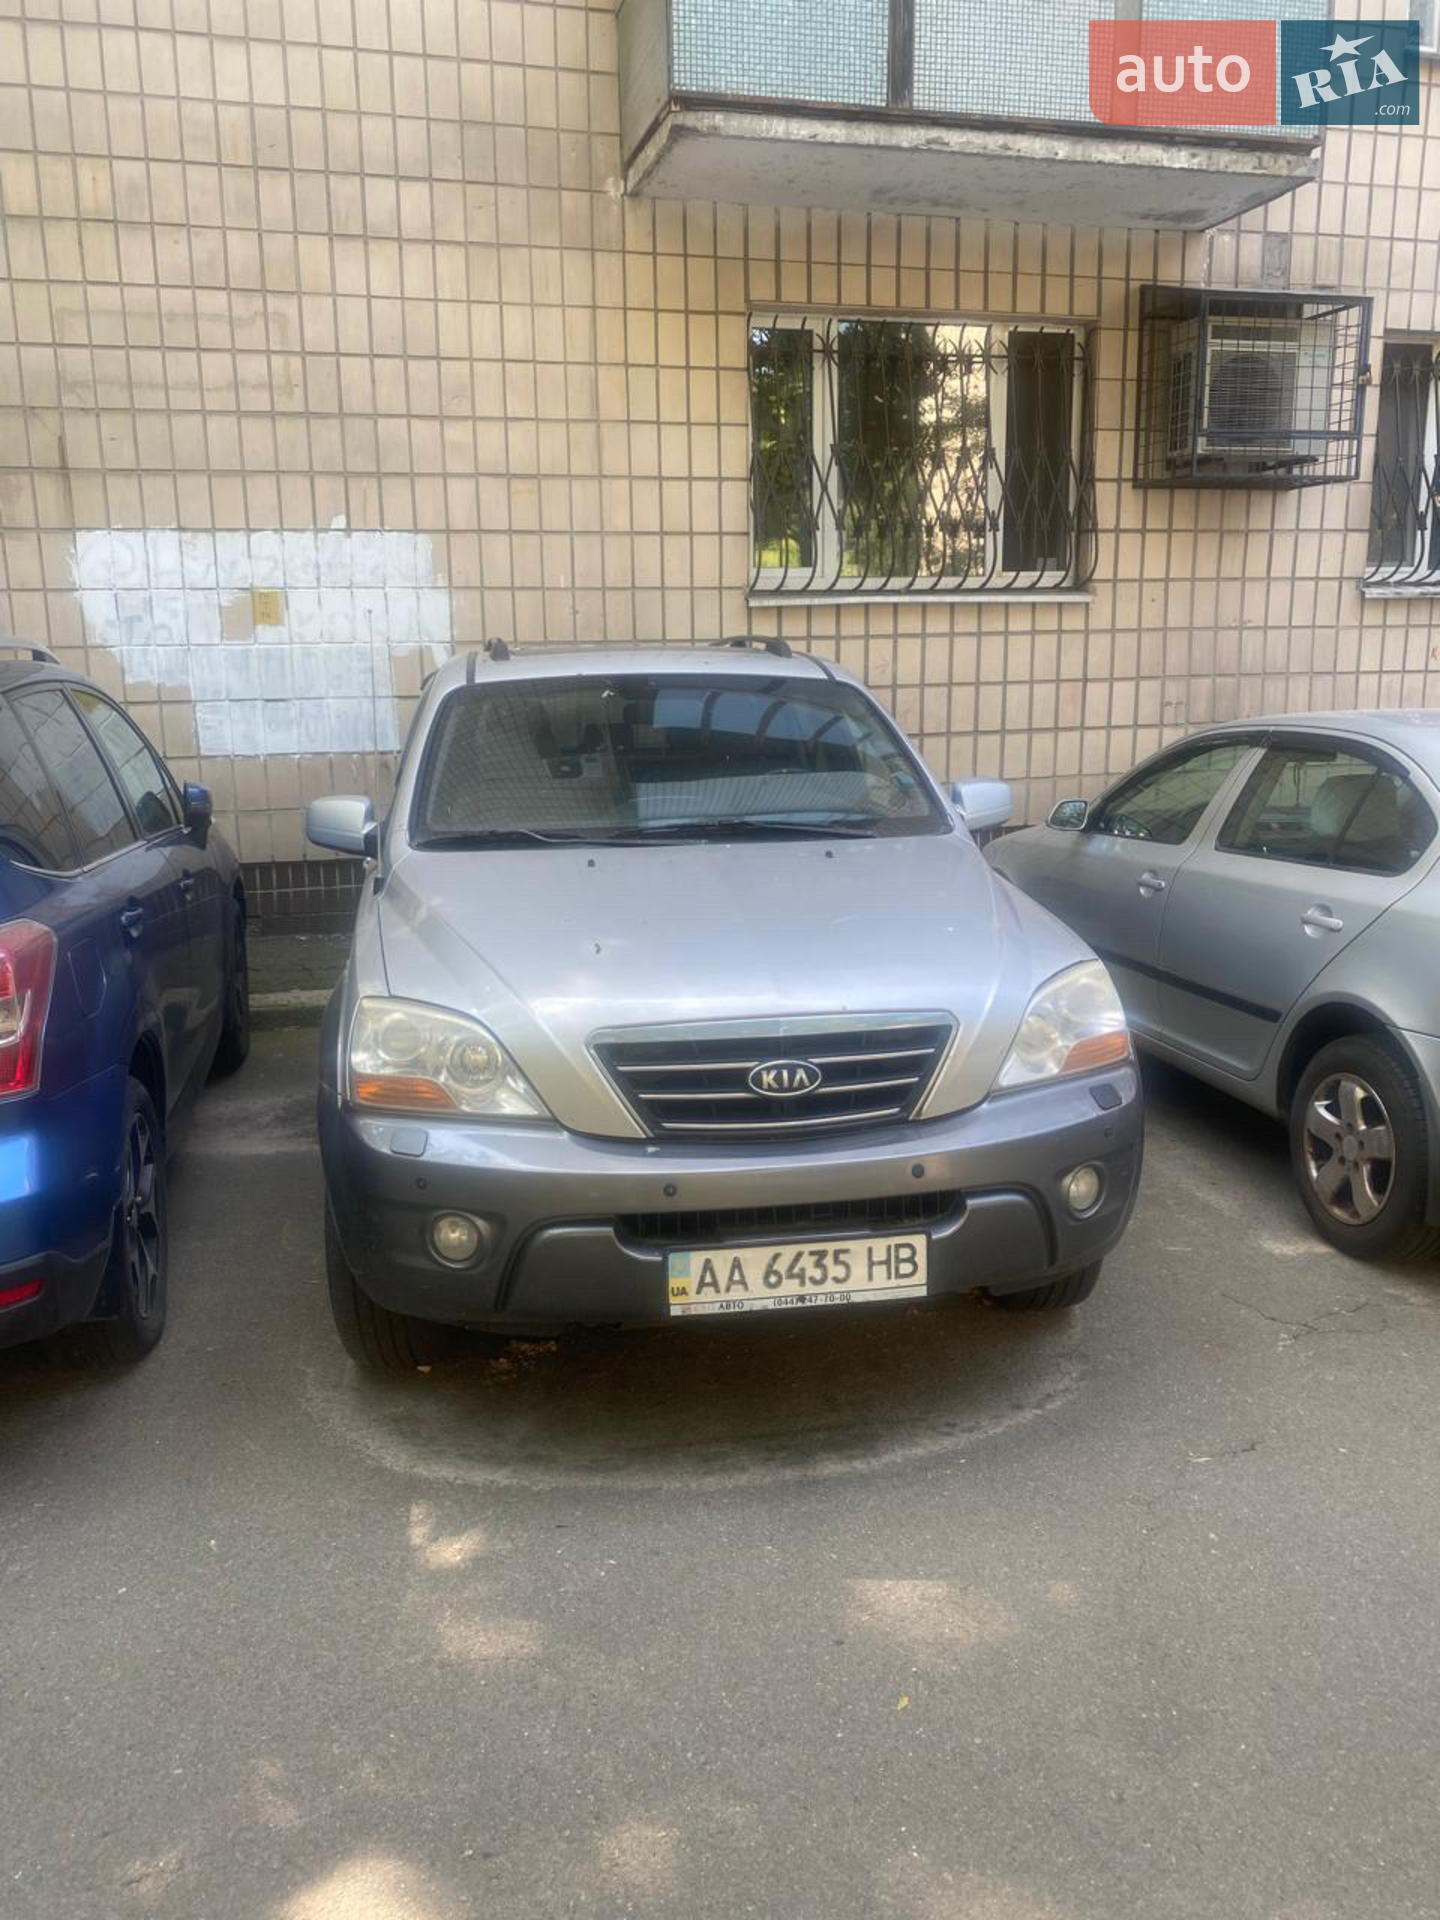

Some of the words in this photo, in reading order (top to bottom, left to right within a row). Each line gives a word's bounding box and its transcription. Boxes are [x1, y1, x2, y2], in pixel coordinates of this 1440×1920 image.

[761, 1067, 811, 1090] KIA
[695, 1255, 750, 1296] AA
[762, 1248, 851, 1289] 6435
[866, 1242, 919, 1282] HB
[671, 1286, 688, 1297] UA
